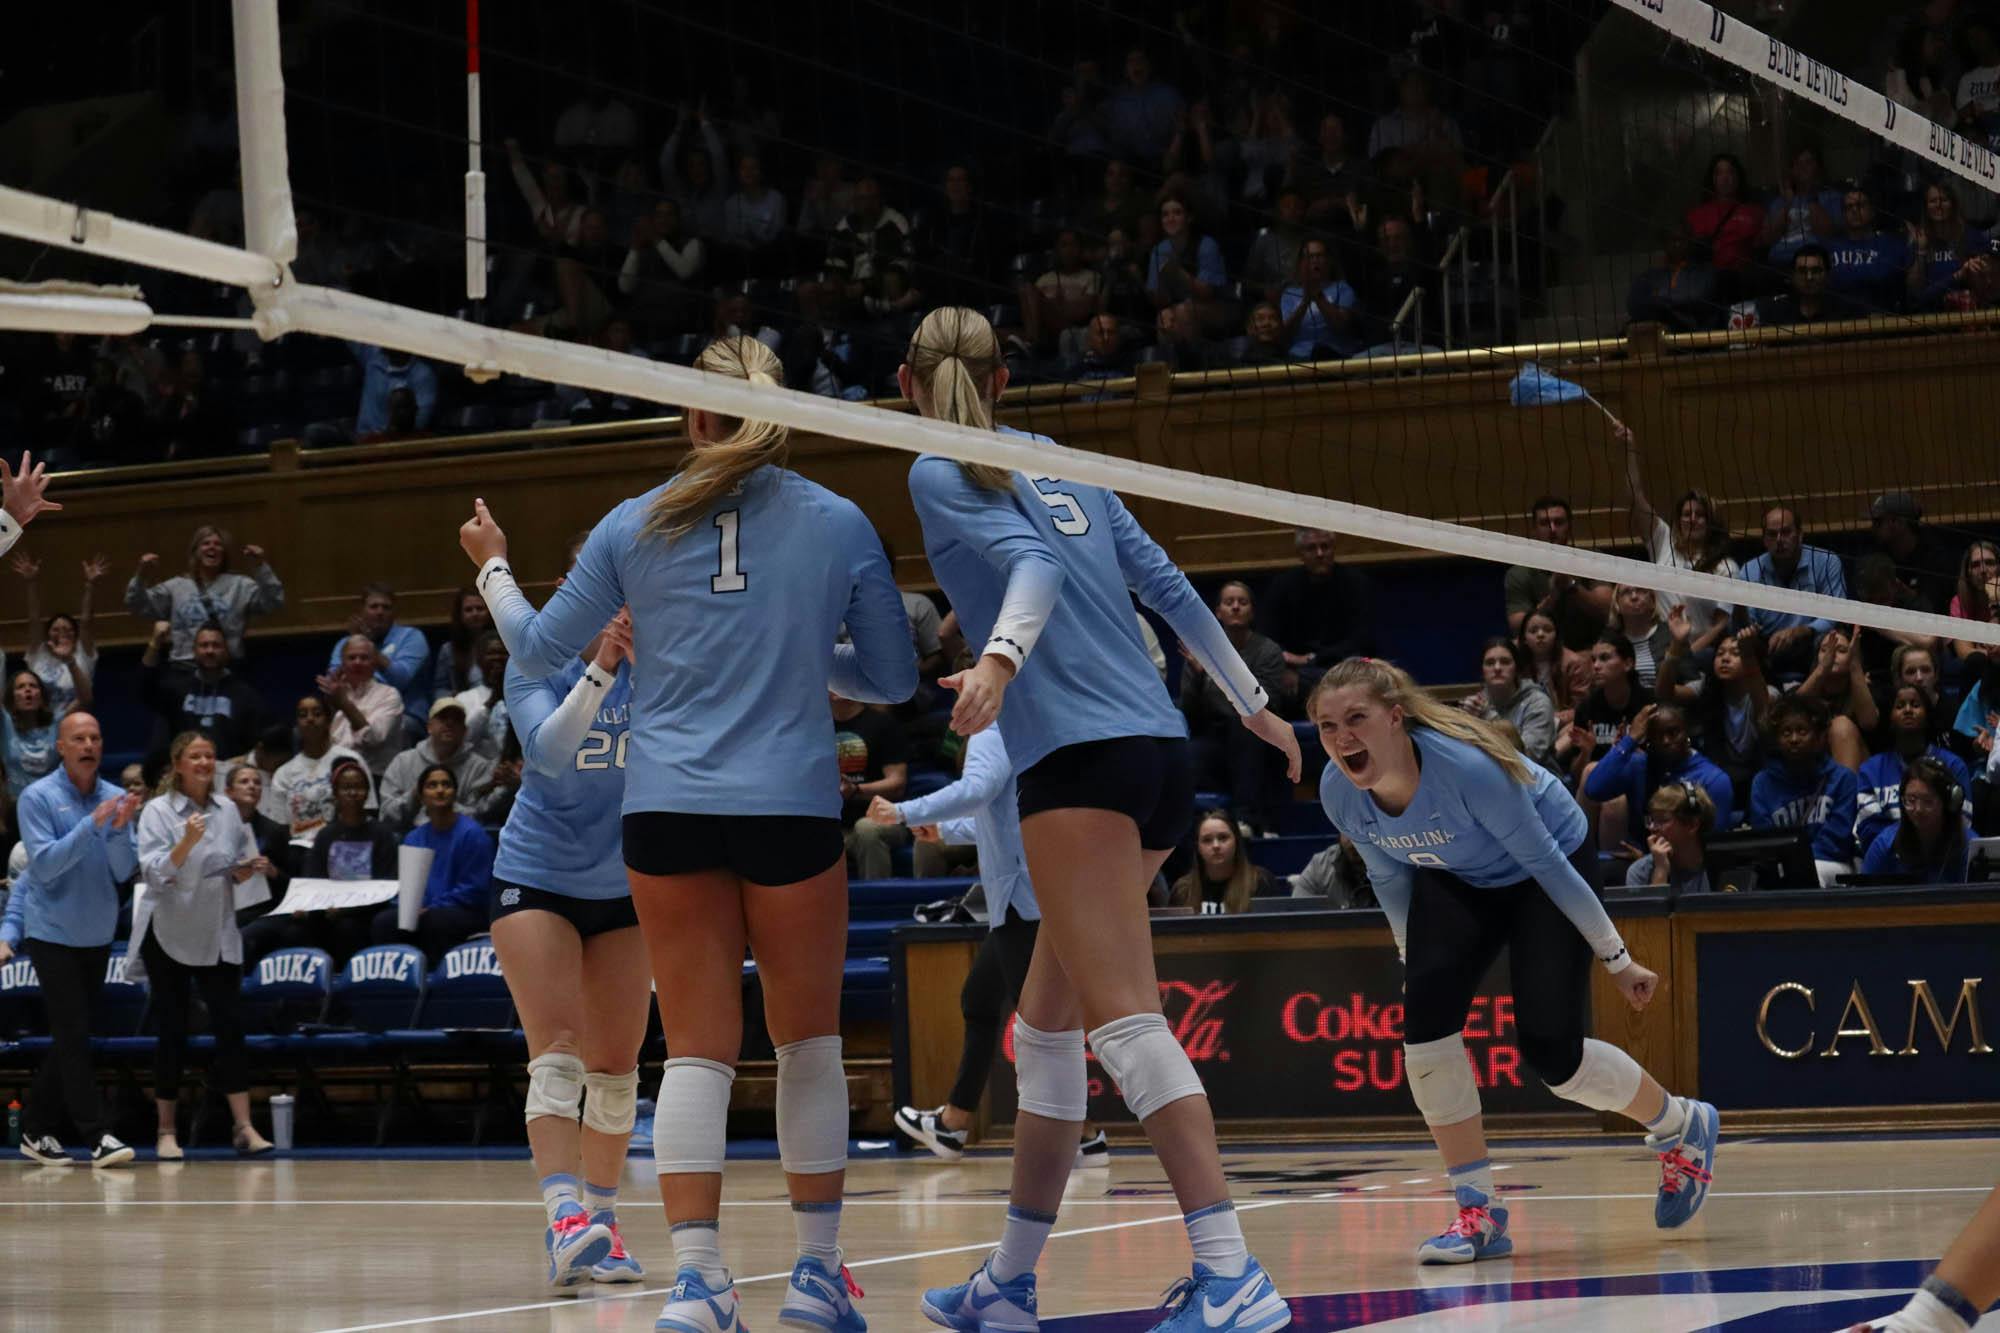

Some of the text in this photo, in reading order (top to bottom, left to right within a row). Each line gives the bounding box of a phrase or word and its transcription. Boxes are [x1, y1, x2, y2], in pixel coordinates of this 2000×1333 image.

[1768, 37, 1848, 106] BLUE DEVILS
[1930, 121, 1996, 180] BLUE DEVILS
[1031, 478, 1091, 536] 5
[711, 507, 747, 595] 1
[260, 953, 324, 986] DUKE
[350, 951, 416, 984] DUKE
[1281, 991, 1405, 1043] Coke
[1756, 977, 1994, 1059] CAM
[1332, 1045, 1525, 1092] SUR
